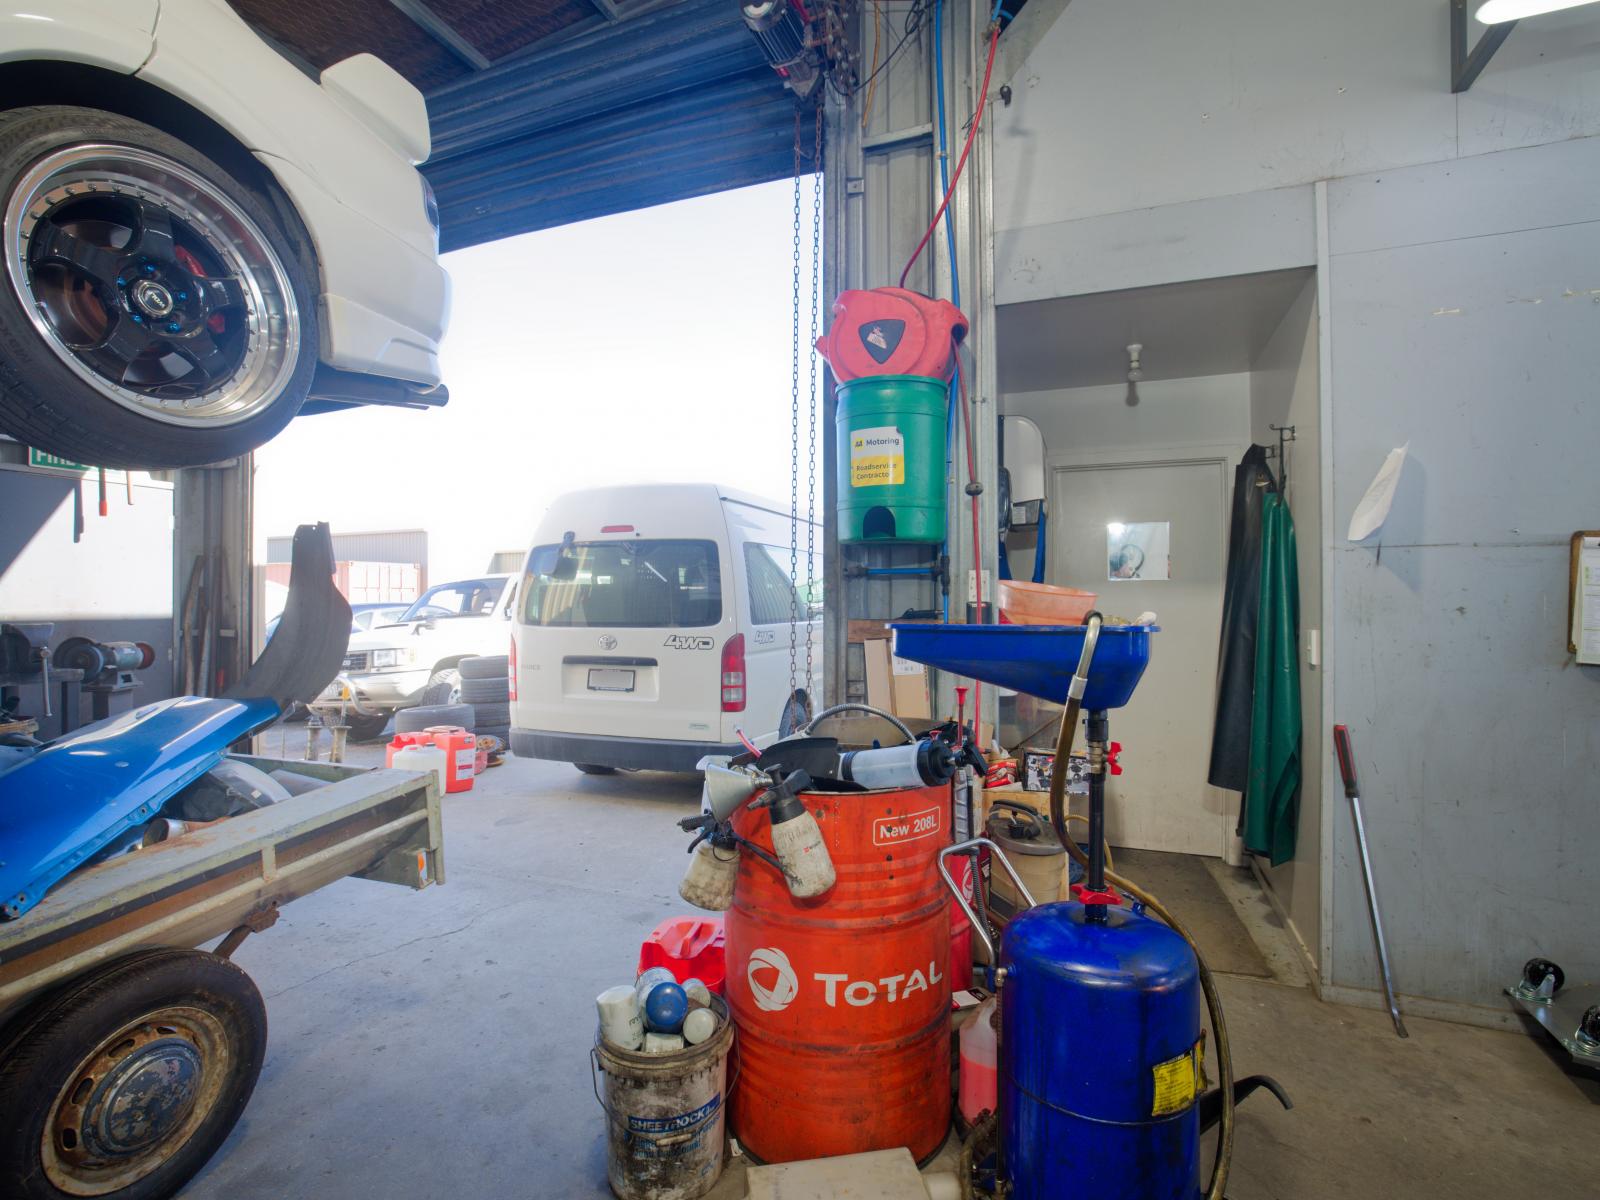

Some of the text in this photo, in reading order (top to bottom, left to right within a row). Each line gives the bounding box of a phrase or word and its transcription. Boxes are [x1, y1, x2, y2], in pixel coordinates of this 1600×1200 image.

[866, 437, 900, 446] Motoring
[856, 472, 892, 480] Contracto
[663, 634, 715, 651] 4WD
[880, 815, 937, 839] New 208L
[813, 961, 943, 1008] TOTAL
